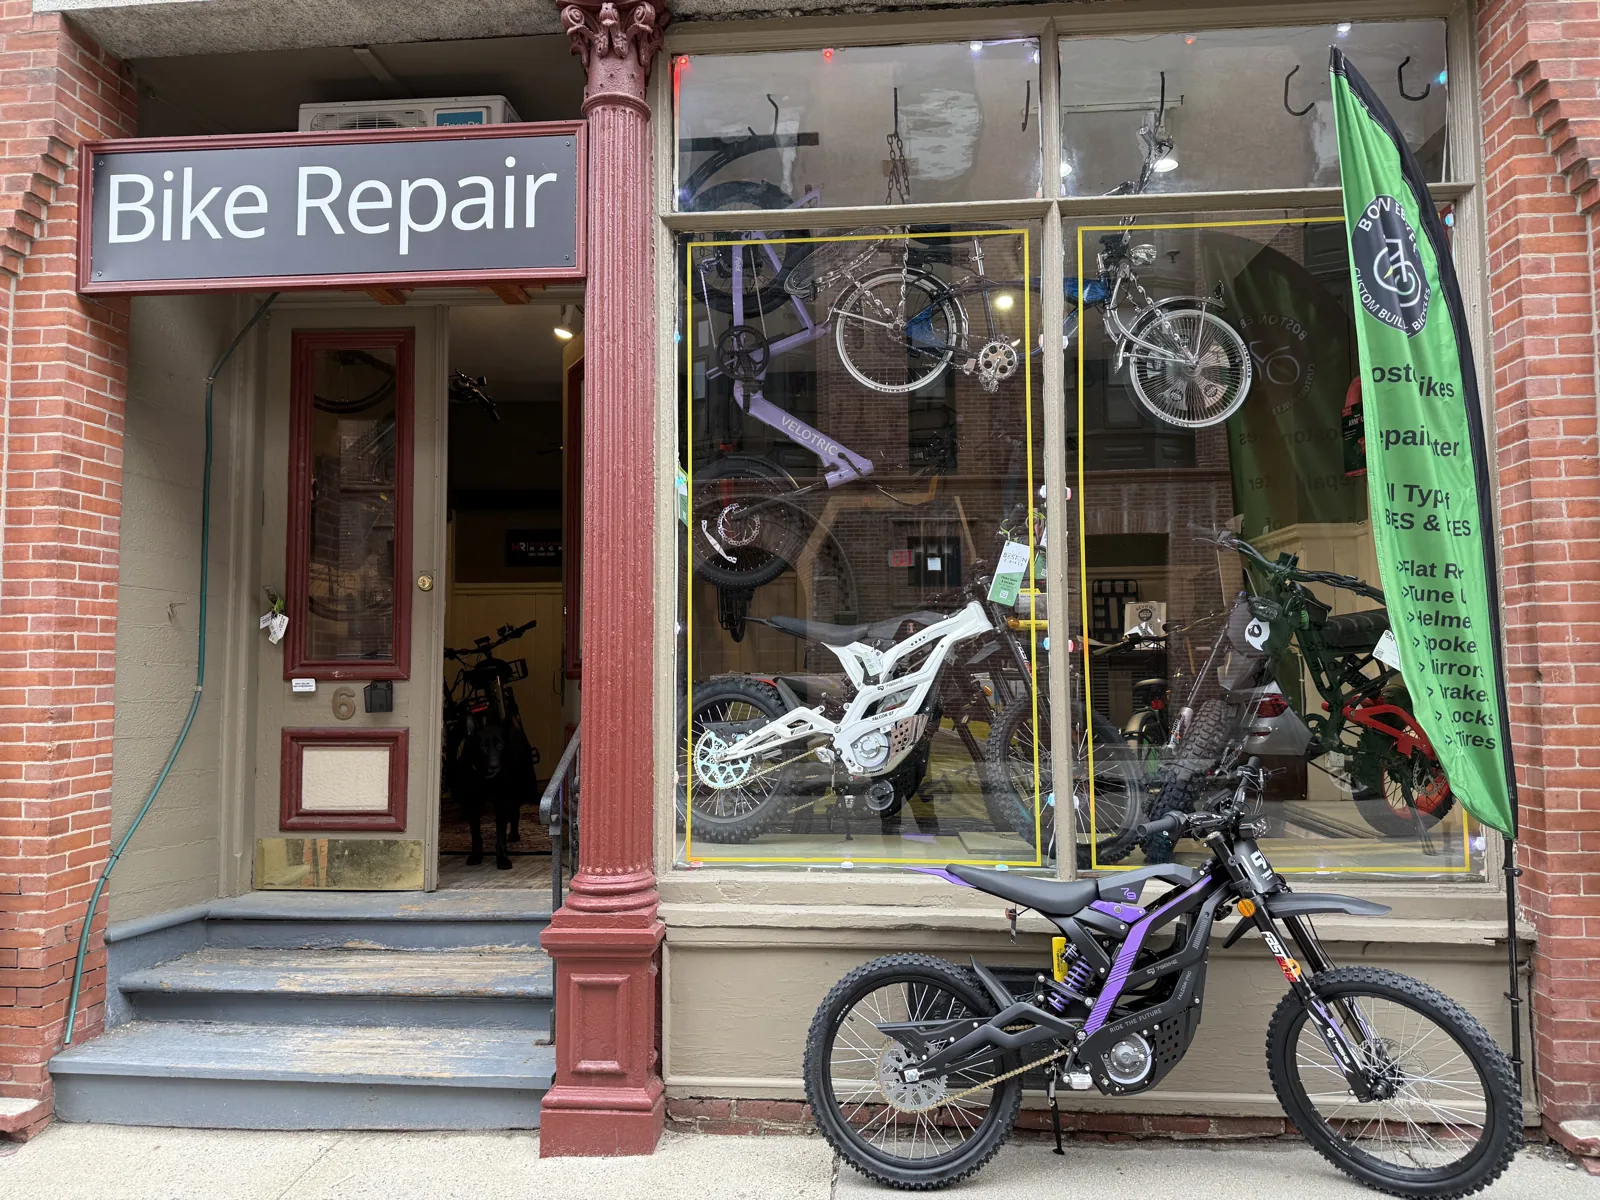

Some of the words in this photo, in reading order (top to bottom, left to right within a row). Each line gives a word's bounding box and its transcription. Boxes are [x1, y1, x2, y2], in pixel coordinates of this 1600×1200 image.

[108, 166, 268, 244] Bike
[297, 156, 558, 255] Repair
[781, 415, 838, 456] VELOTRIC
[1423, 514, 1441, 532] &
[1409, 585, 1454, 604] Tune
[332, 686, 356, 721] 6
[1456, 731, 1497, 750] Tires
[1120, 886, 1137, 900] 79
[1109, 1023, 1124, 1033] RIDE
[1125, 1018, 1138, 1026] THE
[1138, 1007, 1163, 1022] FUTURE
